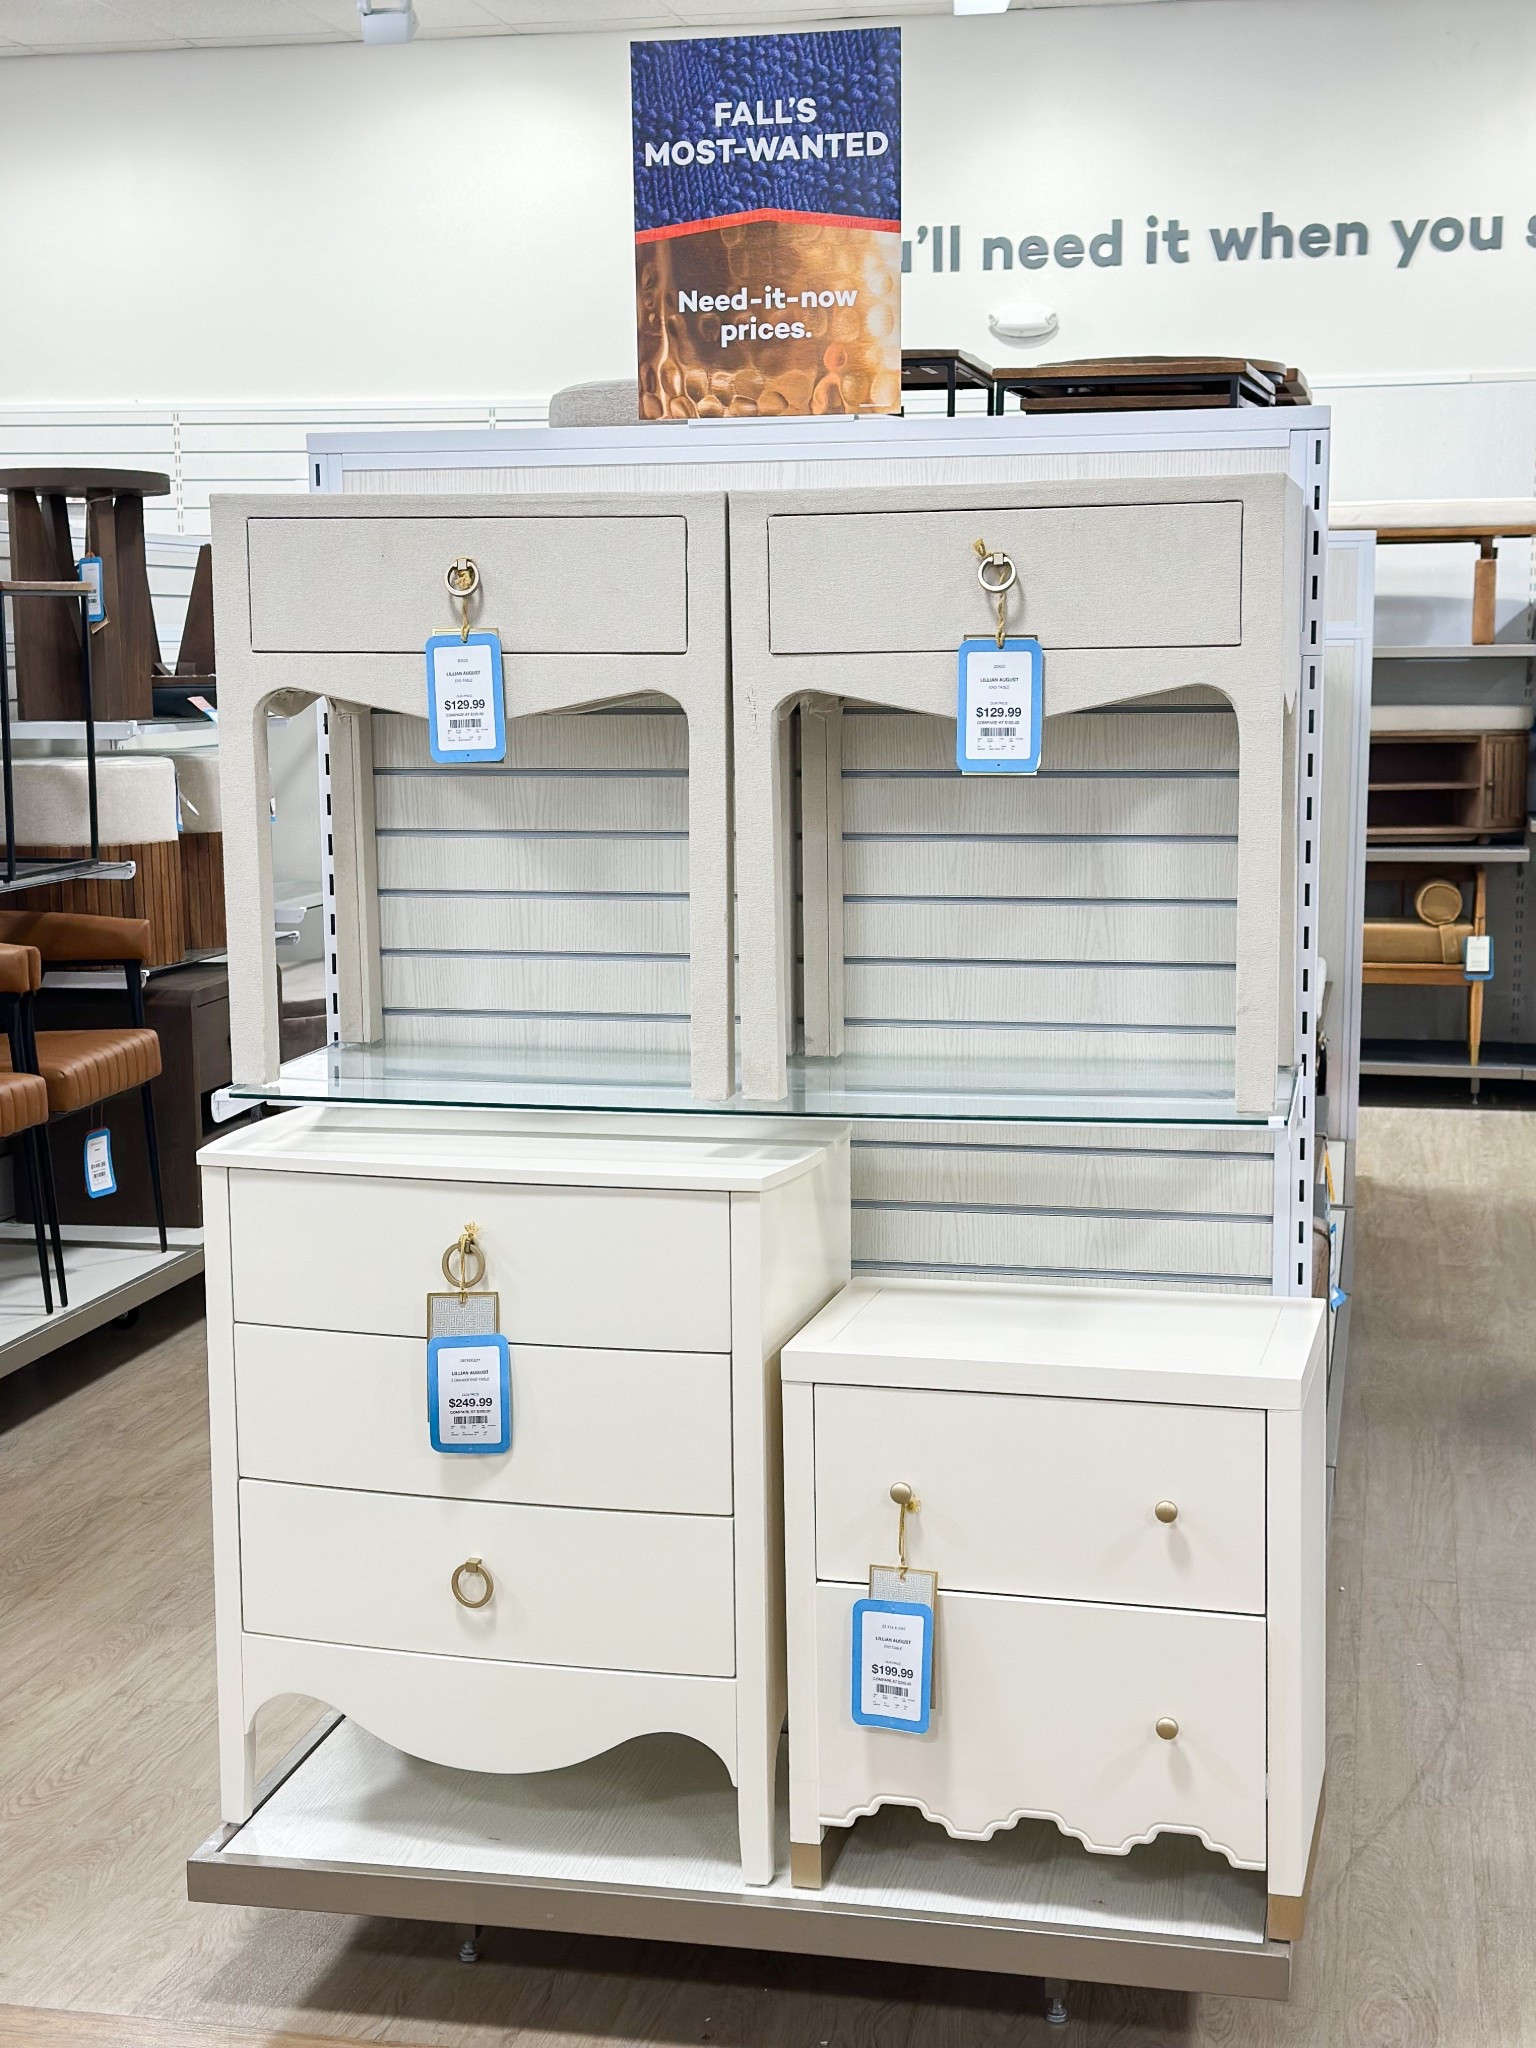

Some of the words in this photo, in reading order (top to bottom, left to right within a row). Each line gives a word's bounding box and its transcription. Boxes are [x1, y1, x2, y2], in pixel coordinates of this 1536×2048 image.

[714, 97, 817, 128] FALL'S
[644, 131, 889, 167] MOST-WANTED
[982, 219, 1123, 271] need
[1146, 215, 1190, 264] it
[1209, 212, 1369, 261] when
[1391, 215, 1503, 268] you
[678, 286, 858, 313] Need-it-now
[721, 316, 813, 347] prices.
[444, 699, 486, 710] $129.99
[976, 706, 1022, 718] $129.99
[448, 1397, 493, 1408] $249.99
[871, 1663, 914, 1679] $199.99
